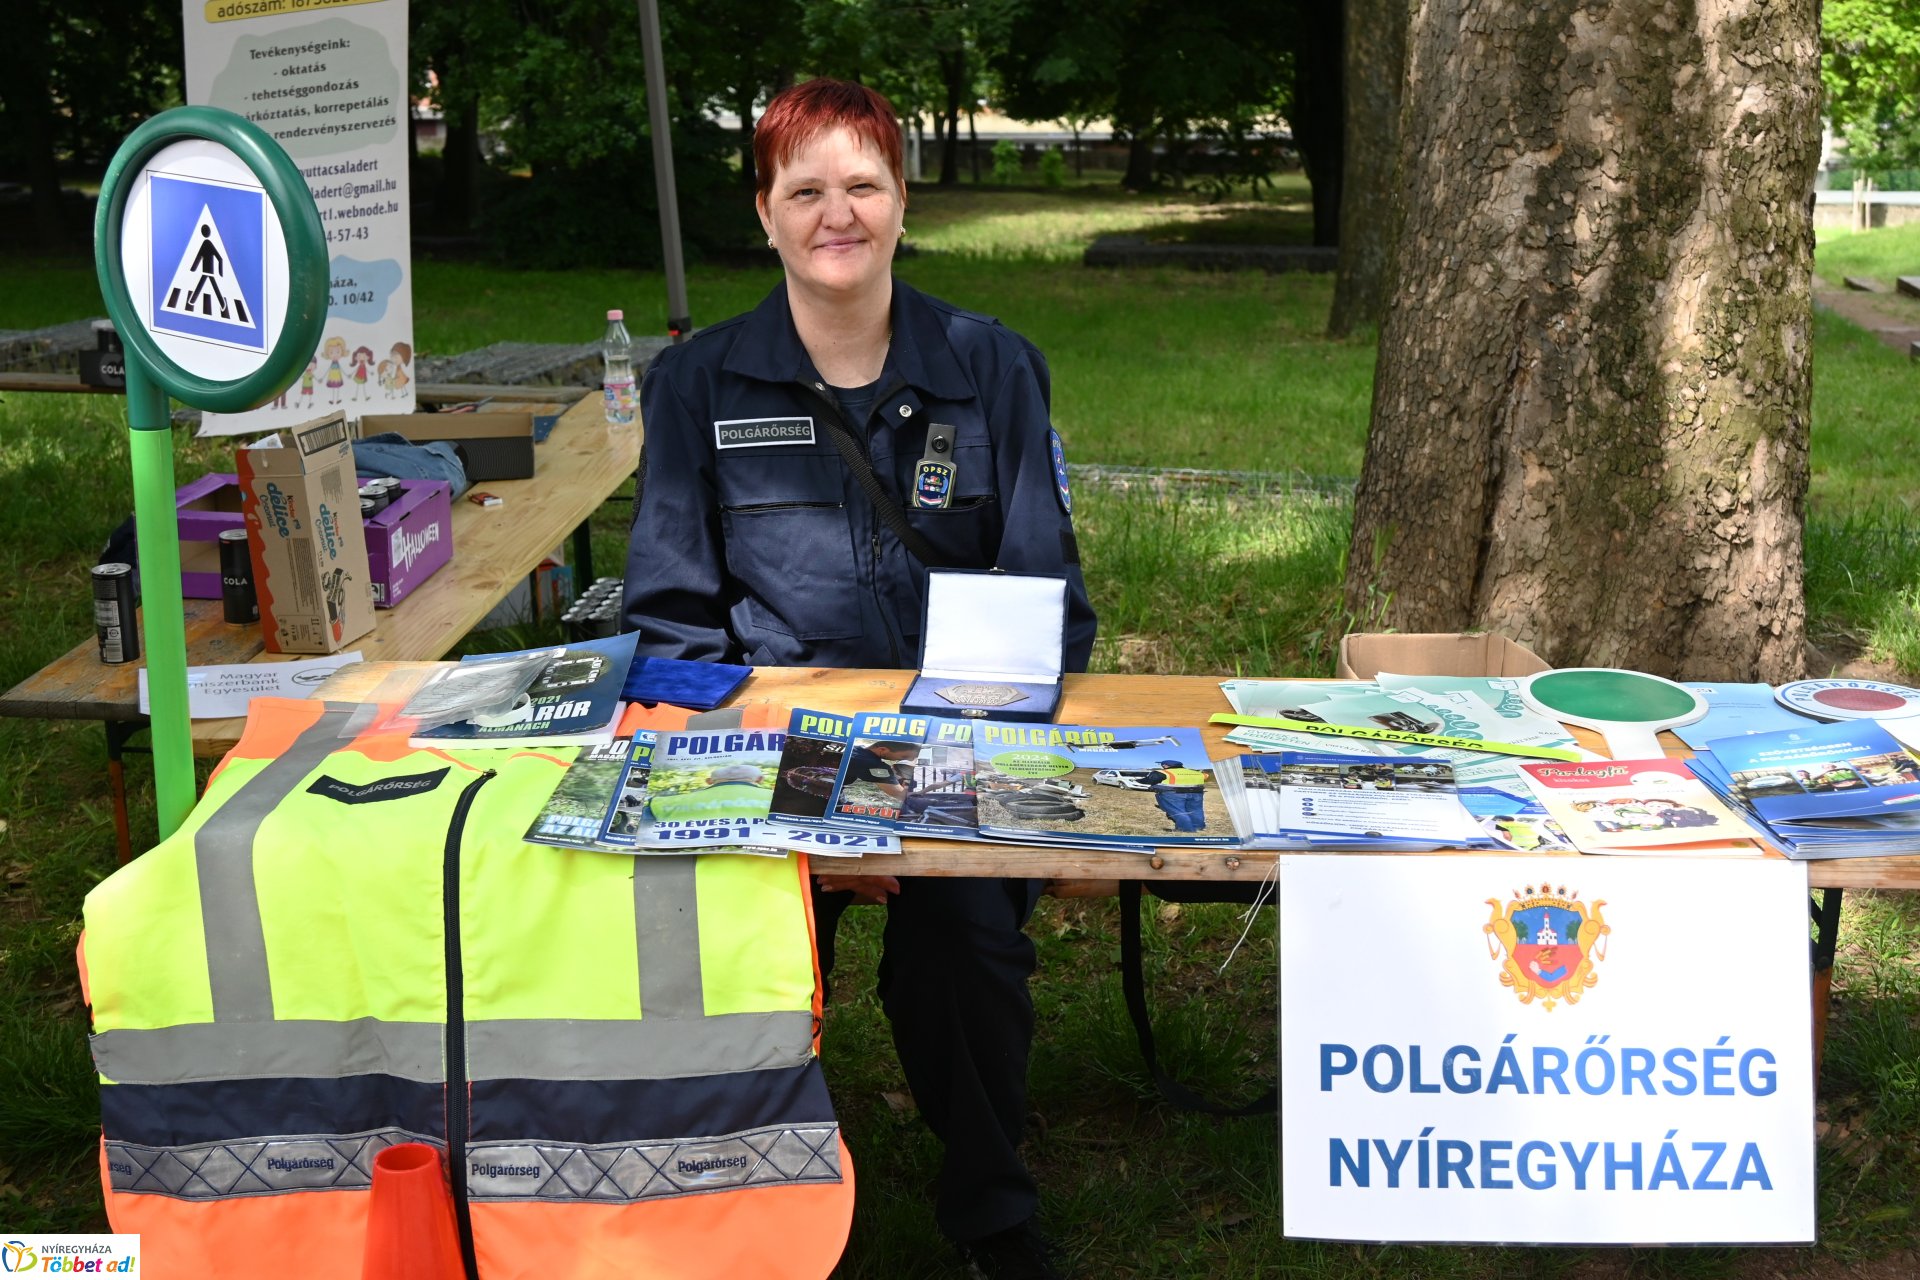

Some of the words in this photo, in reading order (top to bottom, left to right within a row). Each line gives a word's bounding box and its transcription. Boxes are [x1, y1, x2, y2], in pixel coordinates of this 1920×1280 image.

[250, 39, 351, 60] Tevékenységeink:
[281, 63, 327, 77] oktatás
[251, 79, 359, 101] tehetséggondozás
[245, 106, 311, 122] árkóztatás,
[314, 96, 389, 115] korrepetálás
[274, 116, 396, 140] rendezvényszervezés
[343, 290, 374, 305] 10/42
[101, 365, 125, 375] COLA
[720, 424, 811, 440] POLGÁRŐRSÉG
[923, 466, 949, 476] OPSZ
[402, 520, 440, 573] HALLOWEEN
[223, 577, 248, 586] COLA
[220, 672, 279, 680] Magyar
[530, 694, 561, 708] 2021
[862, 716, 927, 737] POLG
[668, 731, 786, 756] POLGÁR
[984, 726, 1116, 748] POLGÁRŐR
[328, 780, 432, 797] POLGÁRŐRSÉG
[685, 817, 730, 828] ÉVES
[652, 826, 751, 840] 1991
[788, 829, 889, 847] 2021
[1319, 1033, 1778, 1097] POLGÁRŐRSÉG
[267, 1156, 335, 1173] Polgárőrség
[677, 1155, 748, 1174] Polgárőrség
[1328, 1126, 1774, 1191] NYÍREGYHÁZA
[471, 1163, 540, 1179] Polgárőrség
